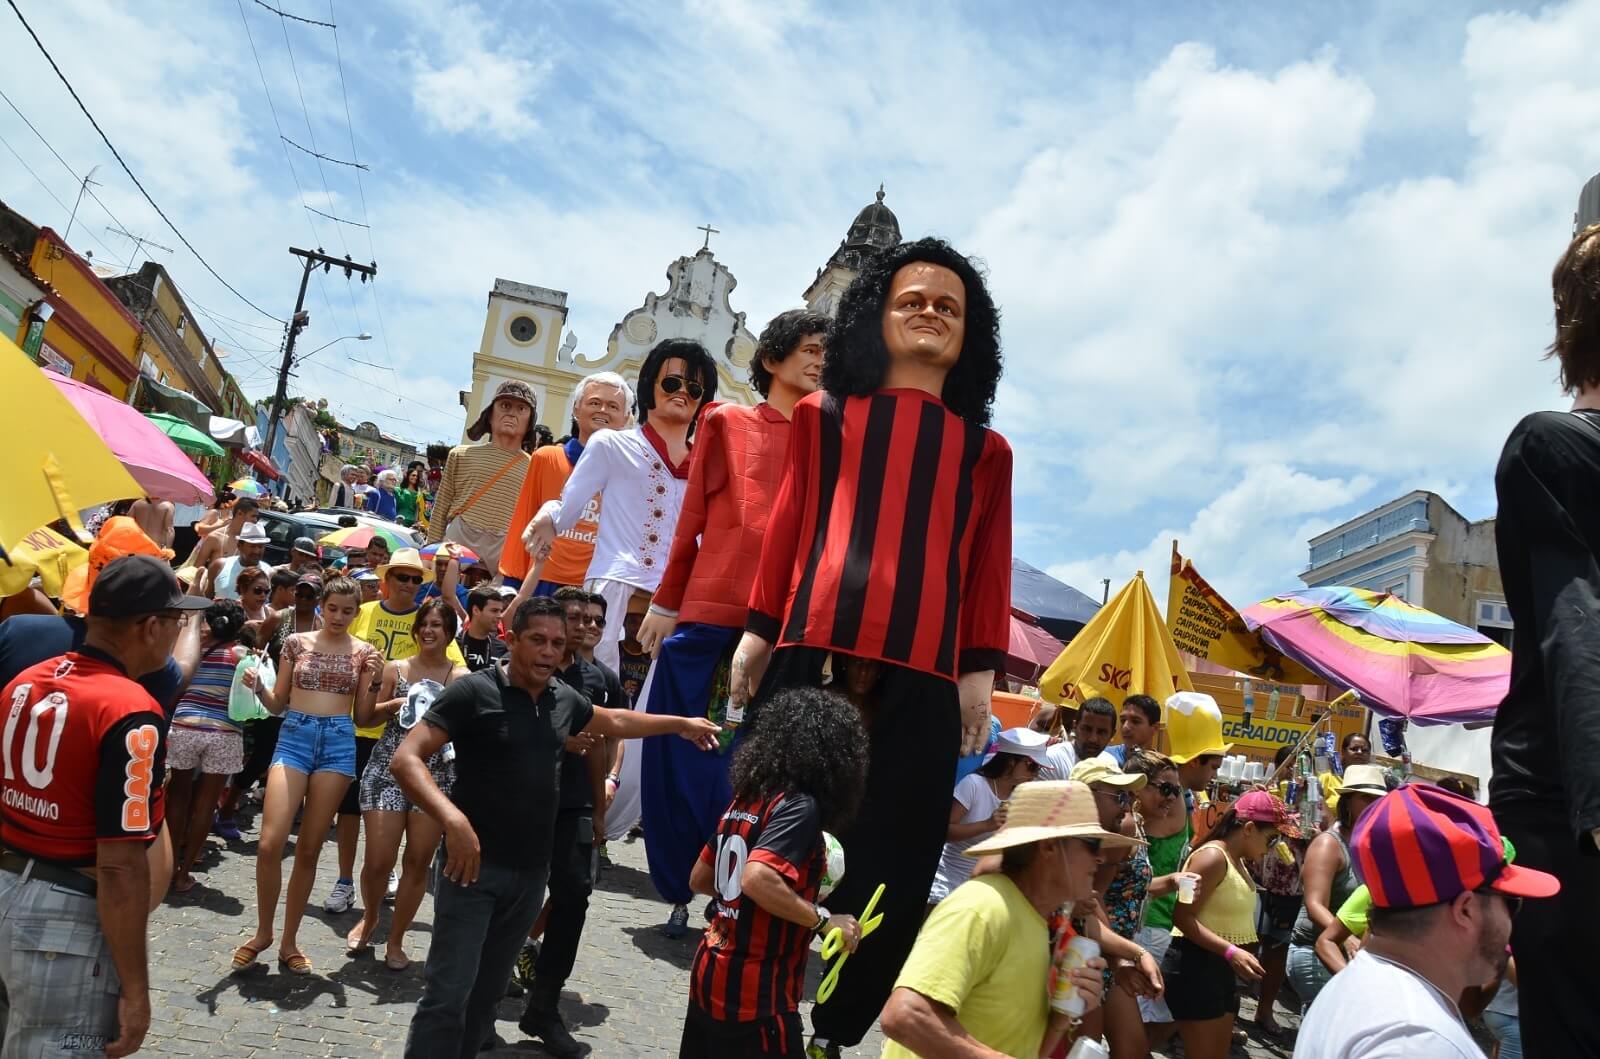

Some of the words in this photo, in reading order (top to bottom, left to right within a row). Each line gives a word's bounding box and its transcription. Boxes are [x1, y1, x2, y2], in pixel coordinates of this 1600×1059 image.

[3, 682, 69, 790] 10
[121, 724, 160, 832] BMG
[1222, 721, 1308, 747] GERADOR
